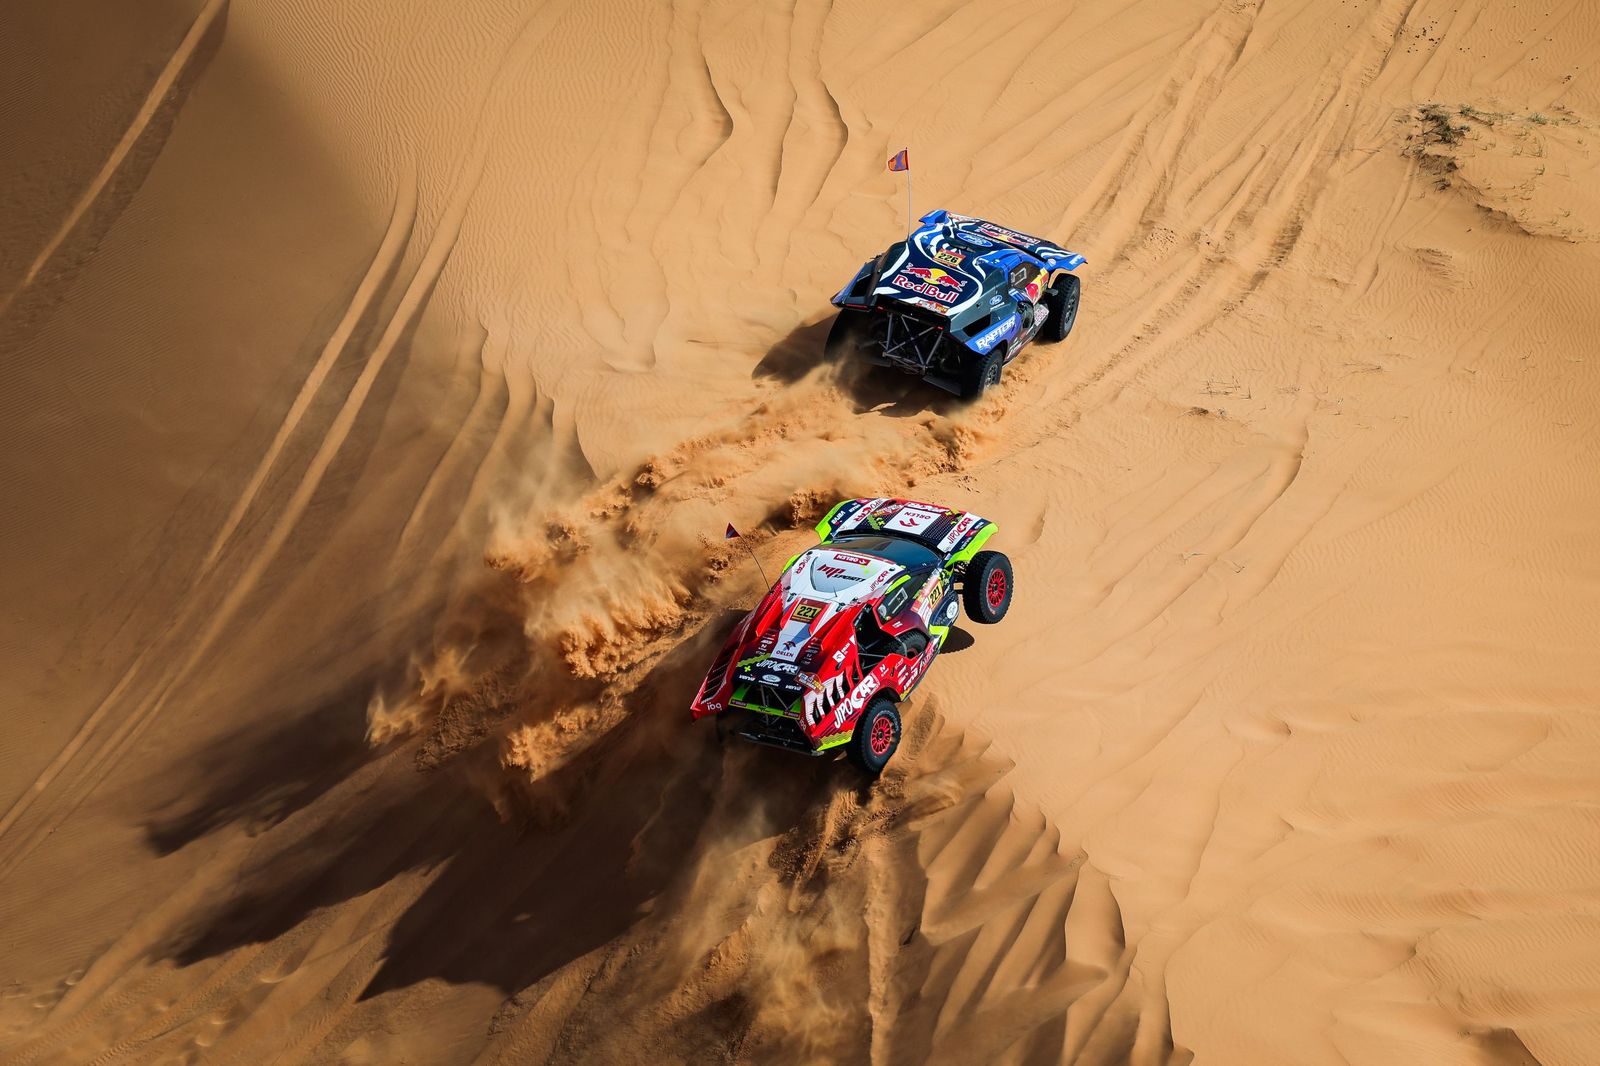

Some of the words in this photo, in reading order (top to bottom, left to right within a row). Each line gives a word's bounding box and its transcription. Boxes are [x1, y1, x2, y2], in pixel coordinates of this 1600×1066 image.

[938, 252, 959, 264] 226
[892, 274, 928, 294] Red
[924, 284, 960, 303] Bull
[975, 315, 1016, 350] RAPTOR
[904, 511, 931, 520] ORLEN
[947, 517, 974, 545] JIPOCAR
[929, 586, 941, 605] 221
[796, 605, 818, 618] 221
[775, 649, 794, 658] ORLEN
[756, 659, 798, 674] JIPOCAR
[834, 674, 878, 729] JIPOCAR
